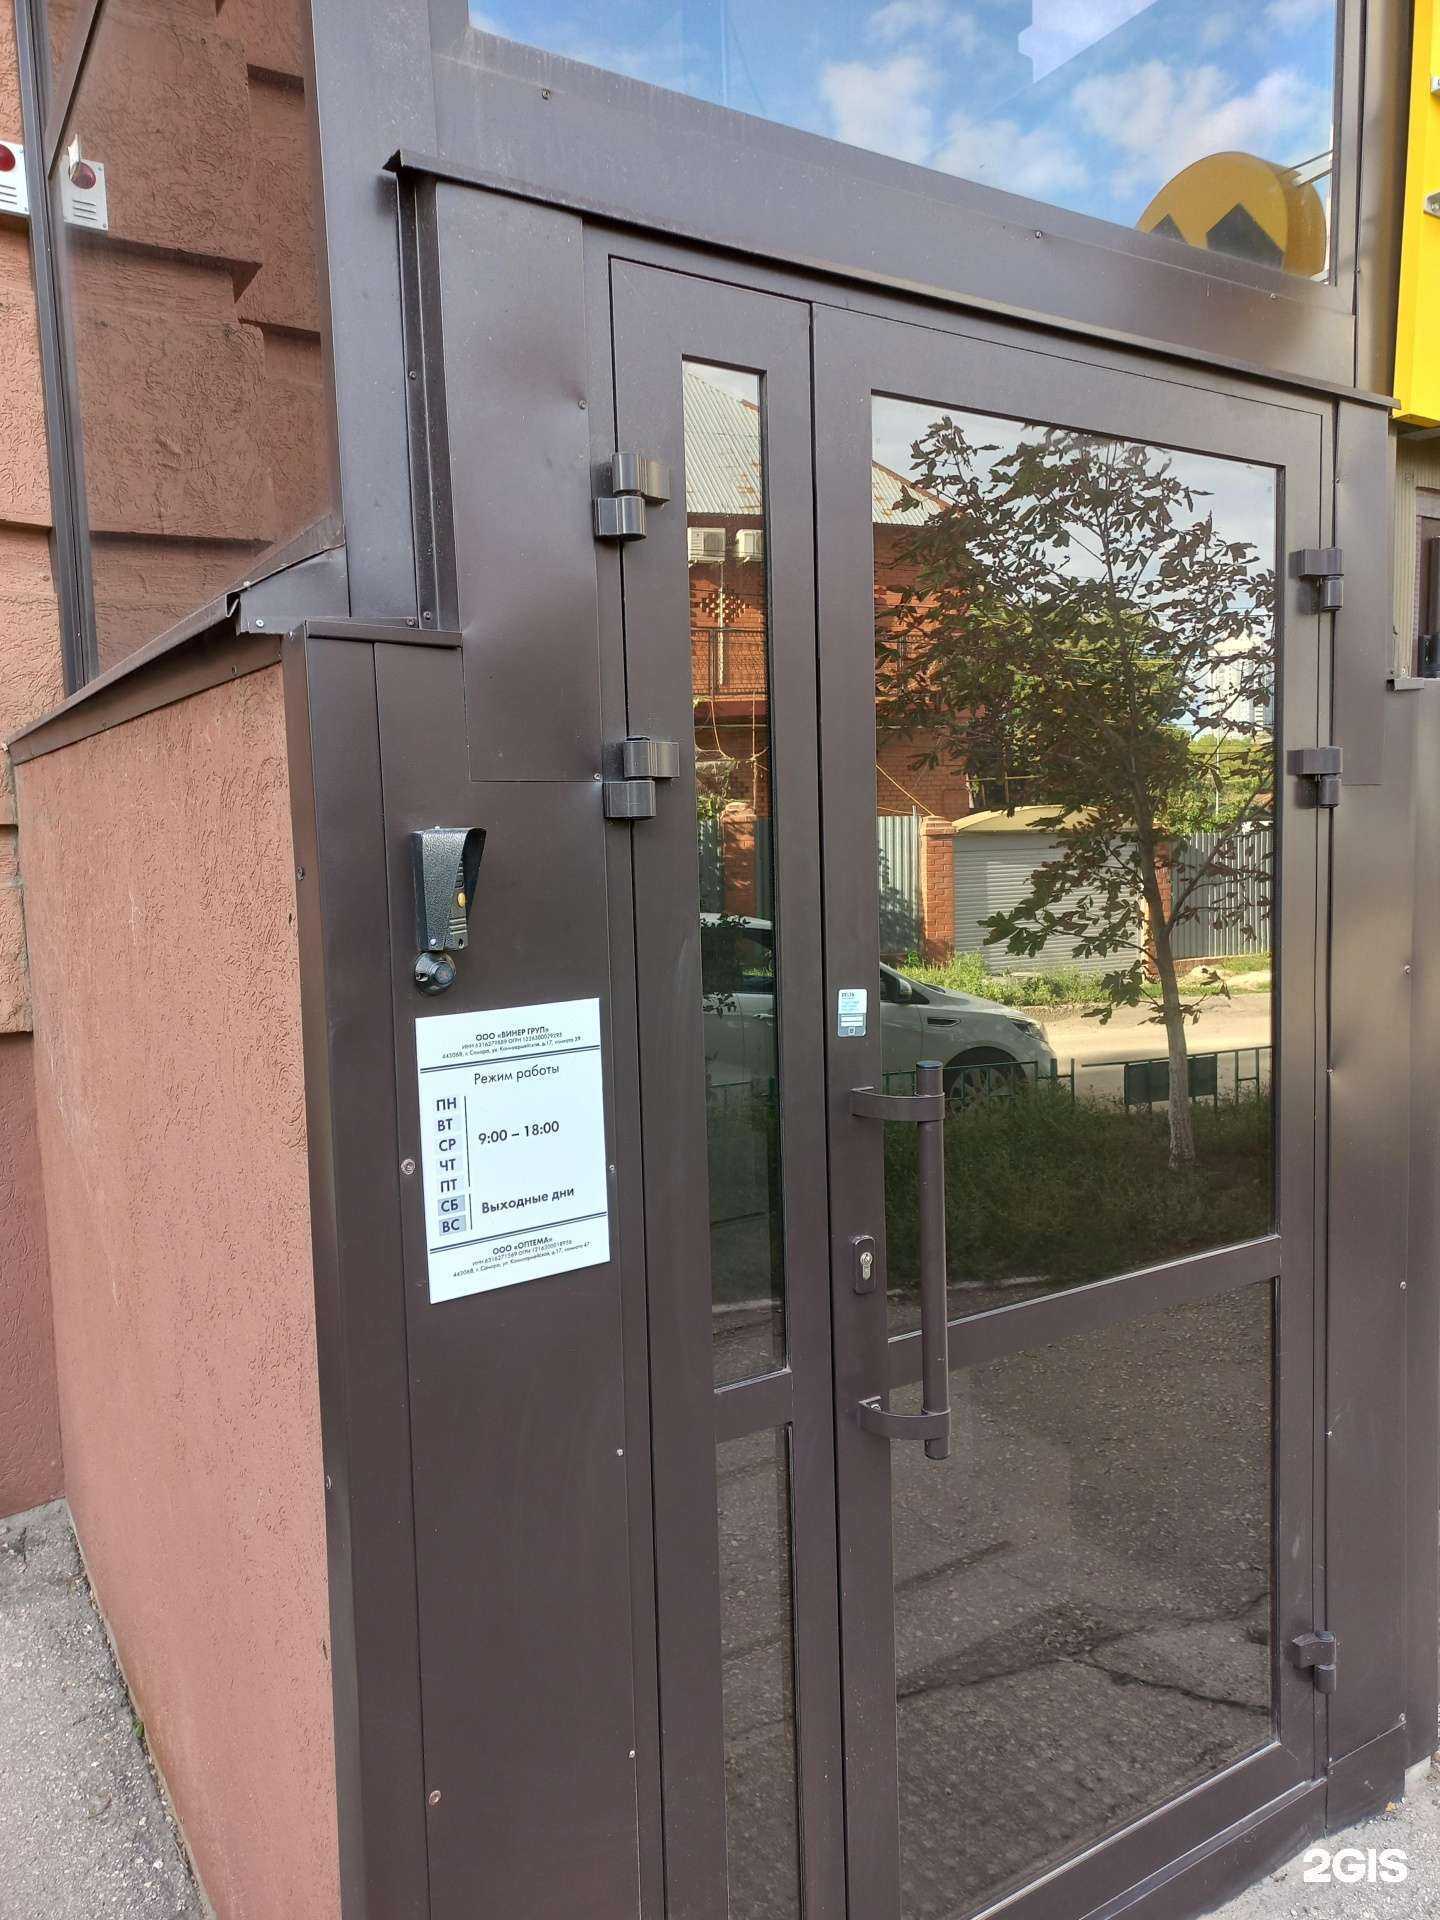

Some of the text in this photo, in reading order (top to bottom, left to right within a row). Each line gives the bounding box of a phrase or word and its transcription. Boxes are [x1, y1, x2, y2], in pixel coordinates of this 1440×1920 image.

[475, 1026, 549, 1041] ООО «ВИНЕР ГРУП»
[474, 1064, 560, 1085] Режим работы
[436, 1097, 457, 1111] ПН
[437, 1118, 453, 1132] ВТ
[478, 1129, 508, 1144] 9:00
[524, 1120, 560, 1137] 18:00
[439, 1138, 456, 1152] СР
[439, 1158, 456, 1172] ЧТ
[440, 1178, 458, 1193] ПТ
[440, 1198, 459, 1212] СБ
[481, 1187, 575, 1214] Выходные дни
[442, 1218, 460, 1233] ВС
[492, 1244, 512, 1255] ООО
